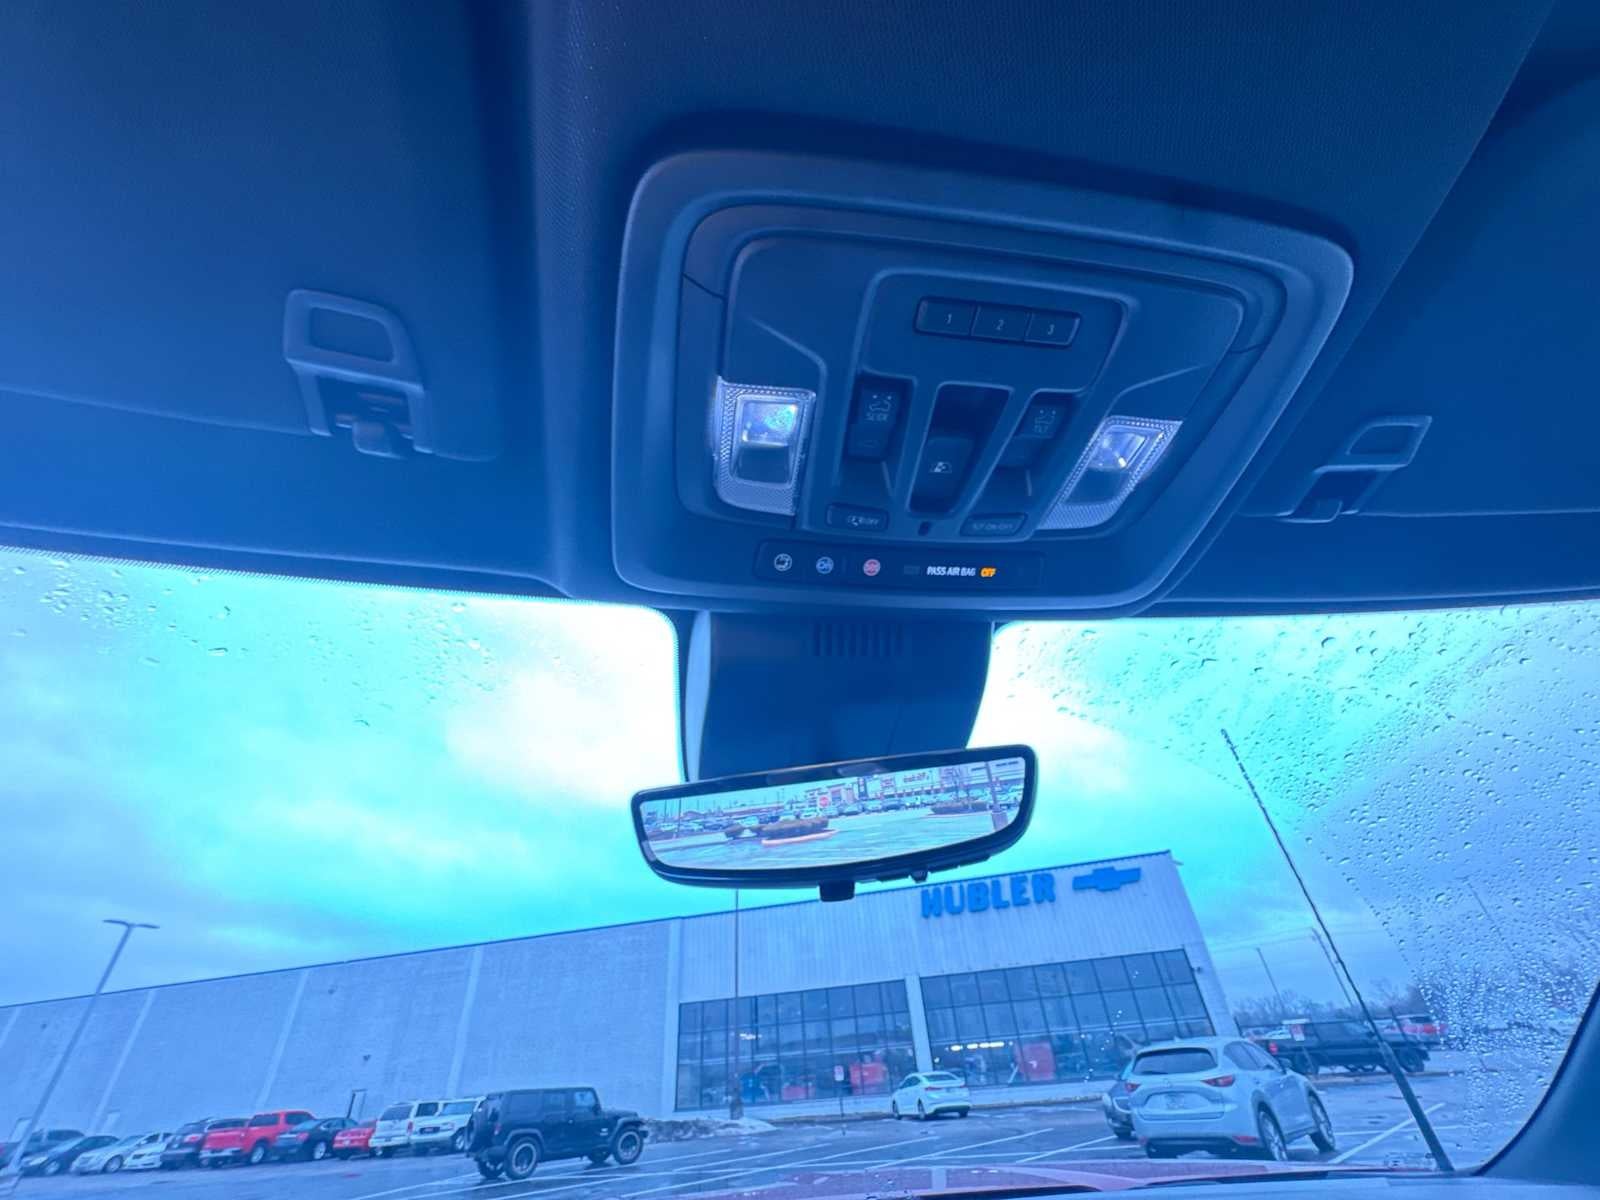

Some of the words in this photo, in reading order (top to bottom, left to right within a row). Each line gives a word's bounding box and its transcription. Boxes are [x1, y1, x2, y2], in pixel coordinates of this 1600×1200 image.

[996, 319, 1005, 330] 2
[1047, 324, 1055, 335] 3
[927, 566, 946, 576] PASS
[947, 566, 960, 577] AIR
[961, 567, 976, 577] BAG
[980, 567, 997, 578] OFF
[921, 872, 1057, 919] HUBLER
